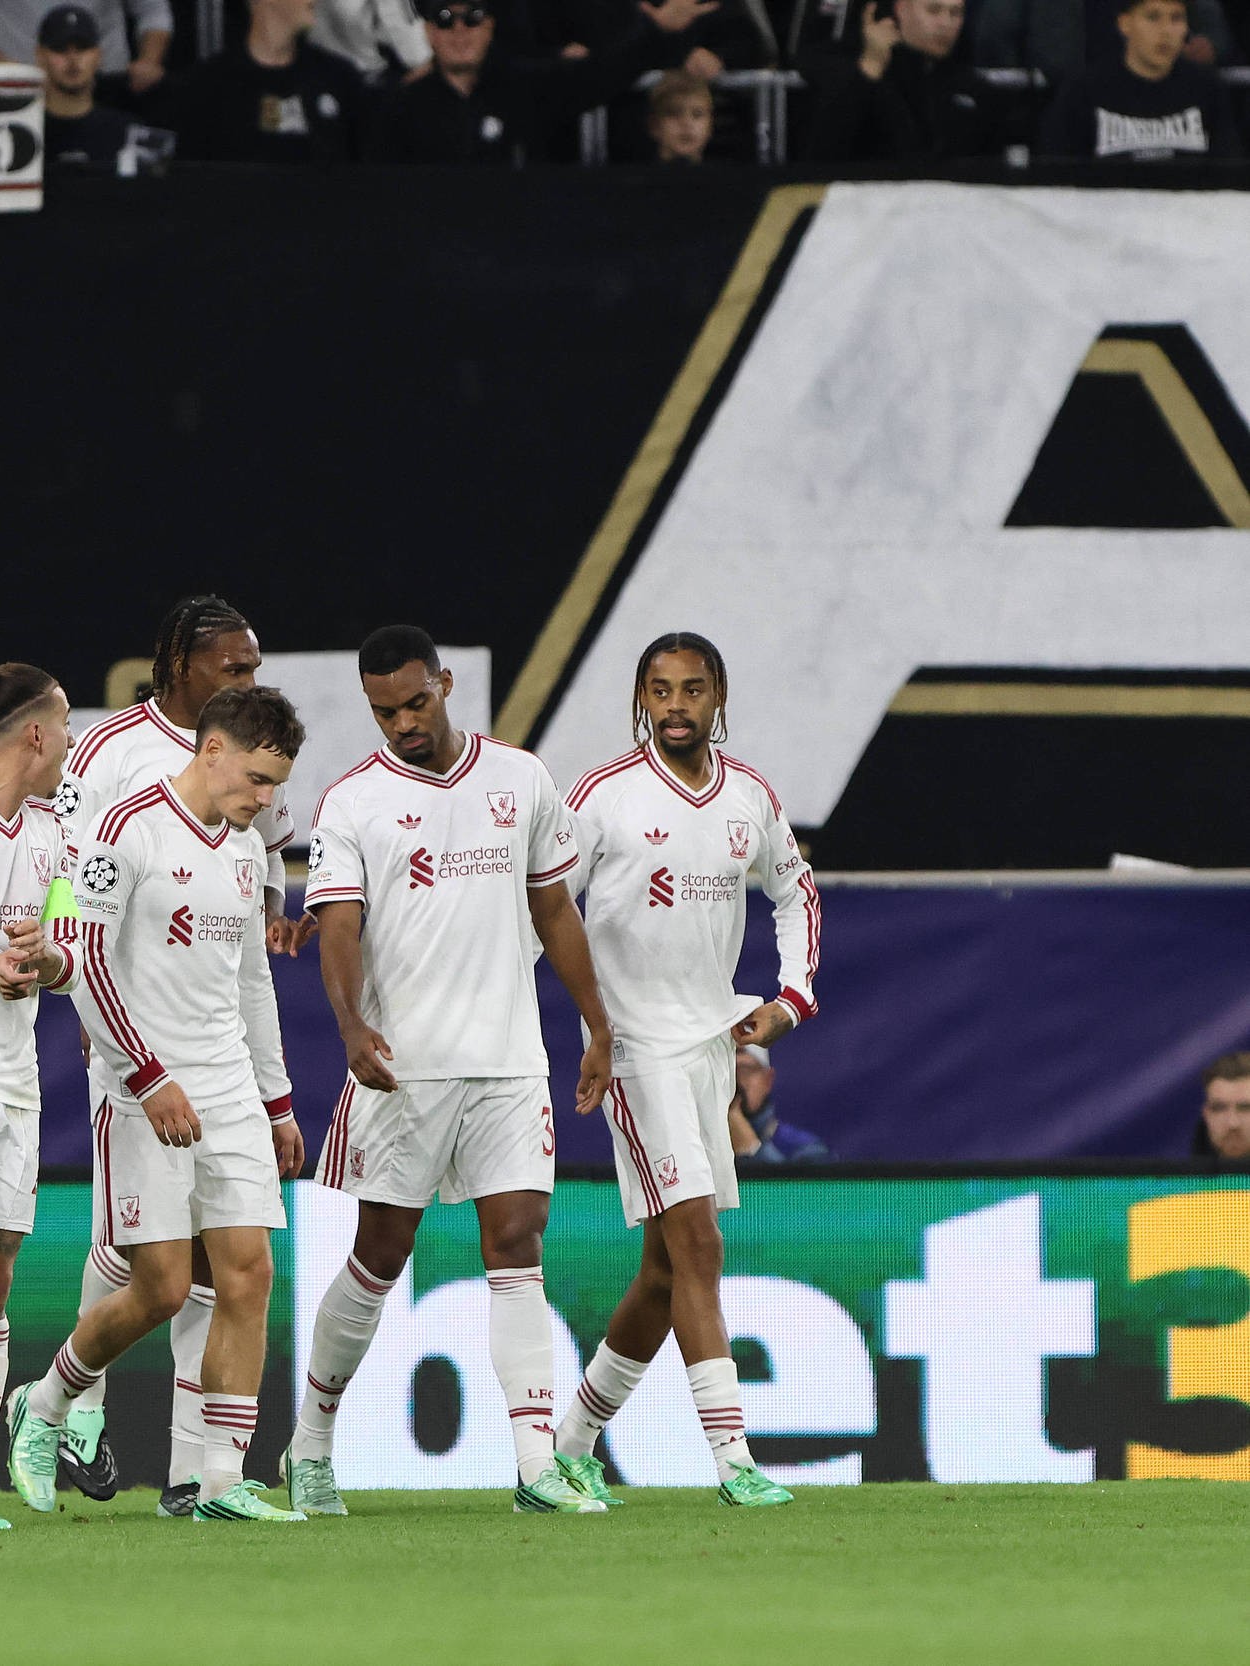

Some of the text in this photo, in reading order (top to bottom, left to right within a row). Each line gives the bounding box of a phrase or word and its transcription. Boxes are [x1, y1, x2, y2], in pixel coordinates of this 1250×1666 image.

[439, 844, 510, 866] standard
[437, 860, 514, 879] chartered
[527, 1388, 554, 1400] LFC
